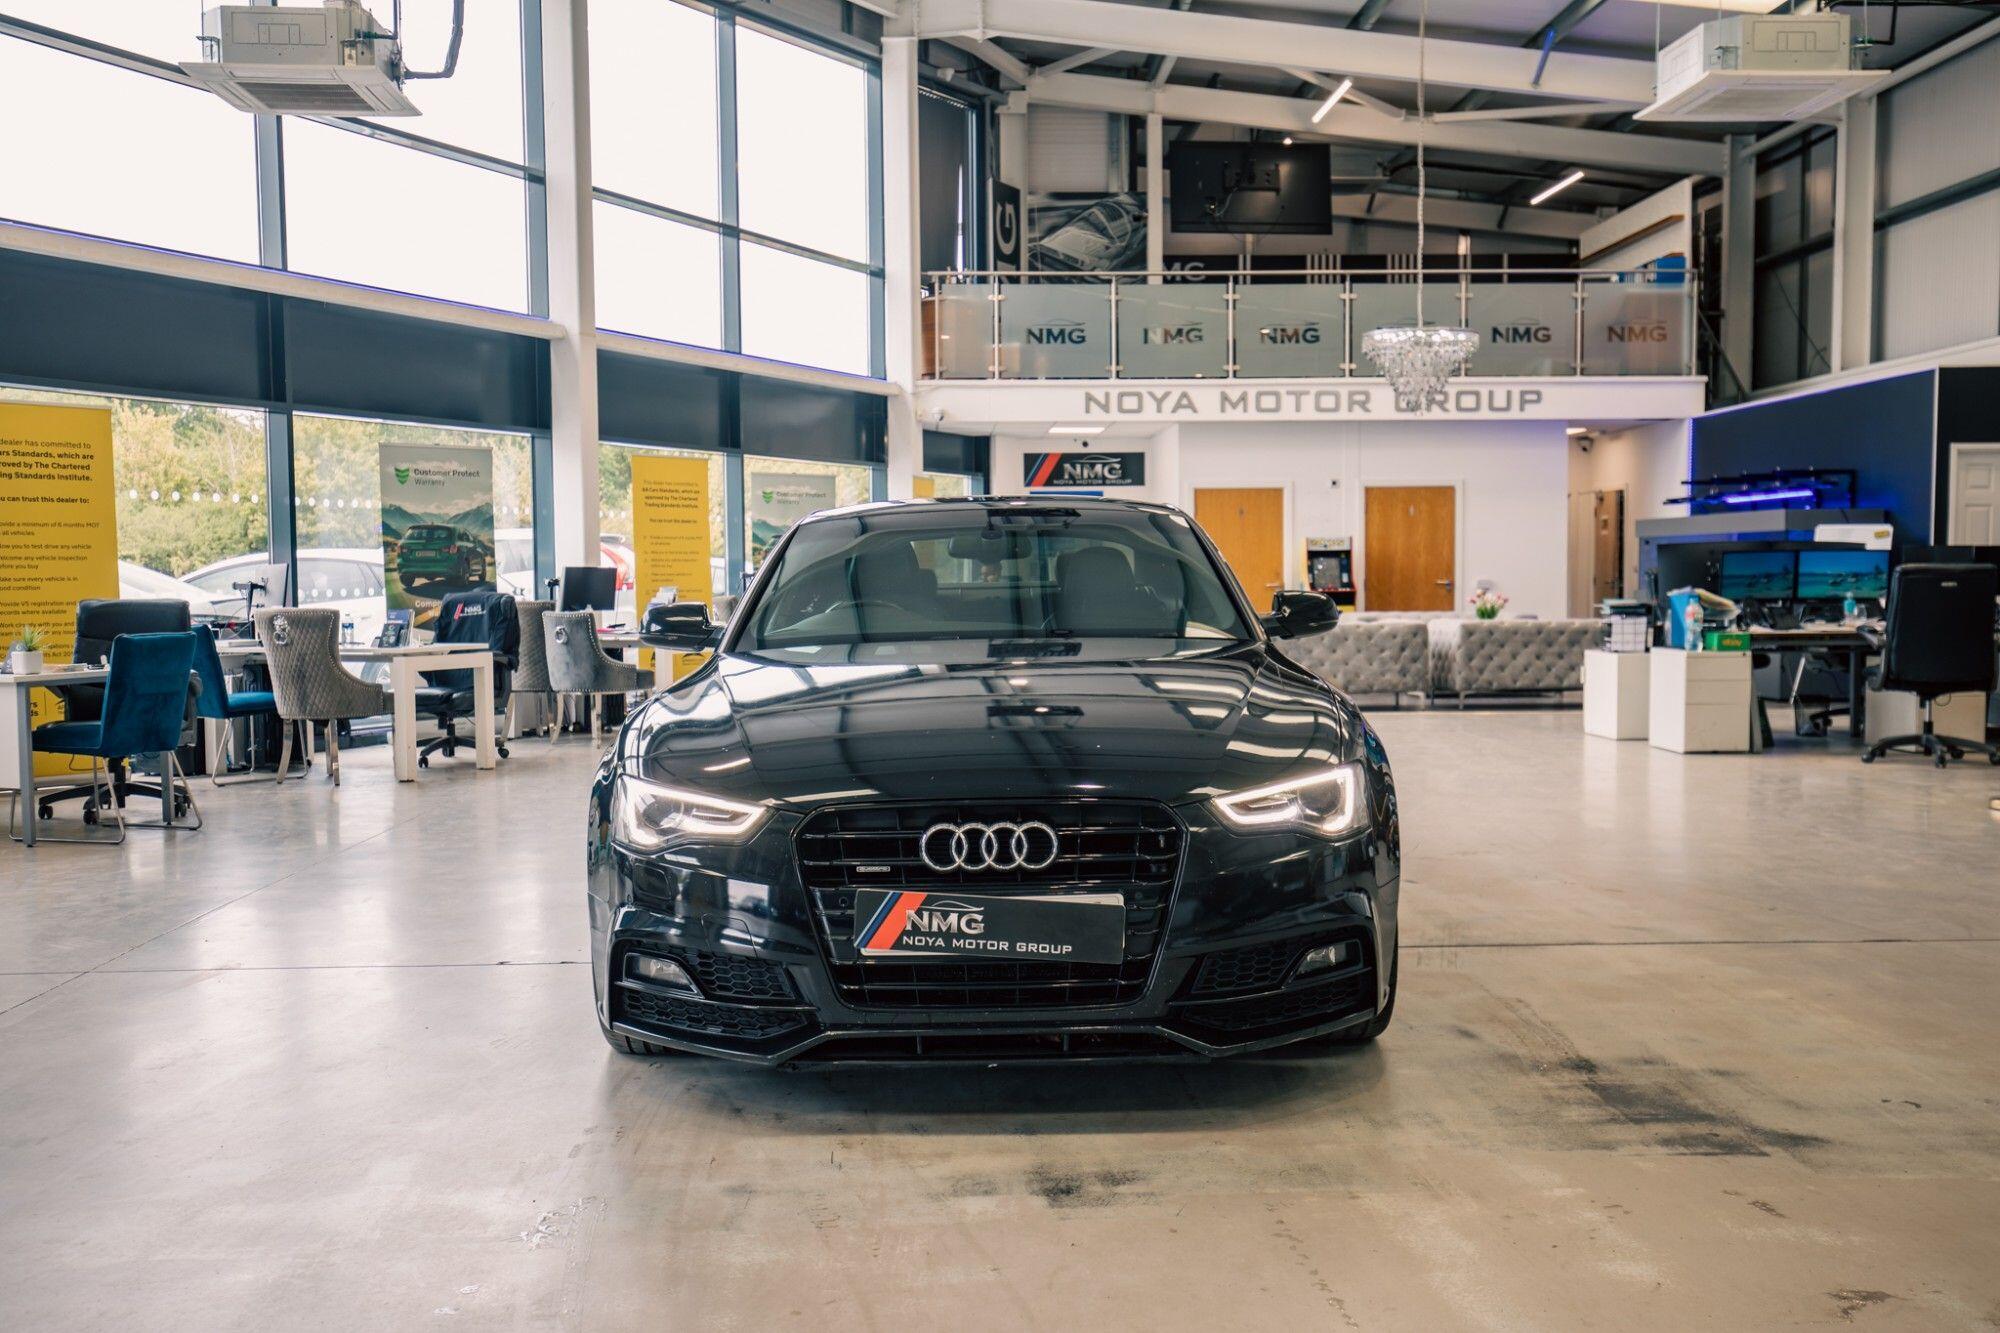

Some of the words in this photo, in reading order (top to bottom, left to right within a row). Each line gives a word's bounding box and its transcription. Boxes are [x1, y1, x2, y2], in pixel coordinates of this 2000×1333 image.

[1026, 327, 1087, 344] NMG
[1143, 327, 1204, 344] NMG
[1260, 327, 1321, 344] NMG
[1492, 326, 1552, 343] NMG
[1607, 325, 1668, 343] NMG
[1084, 391, 1198, 414] NOYA
[1220, 390, 1371, 414] MOTOR
[25, 439, 38, 447] has
[41, 440, 81, 449] committed
[12, 450, 55, 459] Standards,
[57, 452, 80, 460] which
[23, 461, 33, 469] by
[51, 462, 90, 471] Chartered
[413, 468, 450, 476] Customer
[452, 469, 480, 477] Protect
[1063, 462, 1121, 479] NMG
[14, 472, 55, 480] Standards
[904, 909, 985, 935] NMG
[902, 935, 946, 948] NOYA
[952, 937, 1009, 951] MOTOR
[1016, 942, 1072, 955] GROUP
